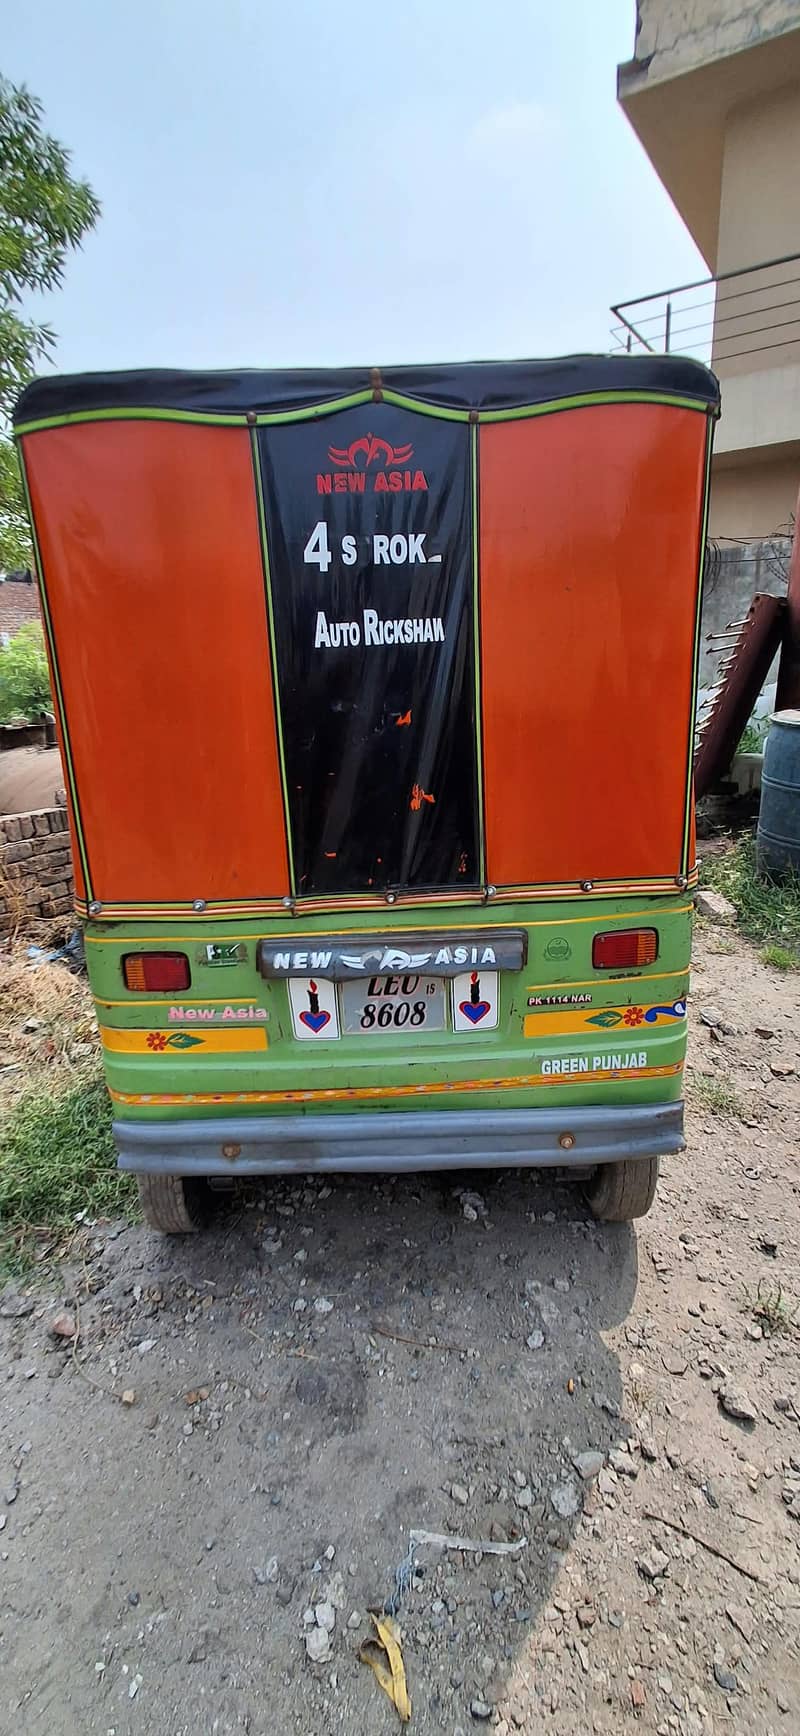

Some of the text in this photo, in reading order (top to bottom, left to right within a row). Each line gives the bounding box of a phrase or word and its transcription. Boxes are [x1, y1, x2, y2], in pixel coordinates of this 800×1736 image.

[316, 470, 428, 495] NEW ASIA
[303, 521, 442, 573] 4 SROK
[314, 611, 361, 648] AUTO
[273, 947, 496, 970] NEW ASIA
[367, 975, 420, 997] LEU
[528, 993, 592, 1006] PK 1114 NAR
[168, 1006, 268, 1020] New Asia
[360, 1001, 426, 1029] 8608
[541, 1052, 648, 1075] GREEN PUNJAB
